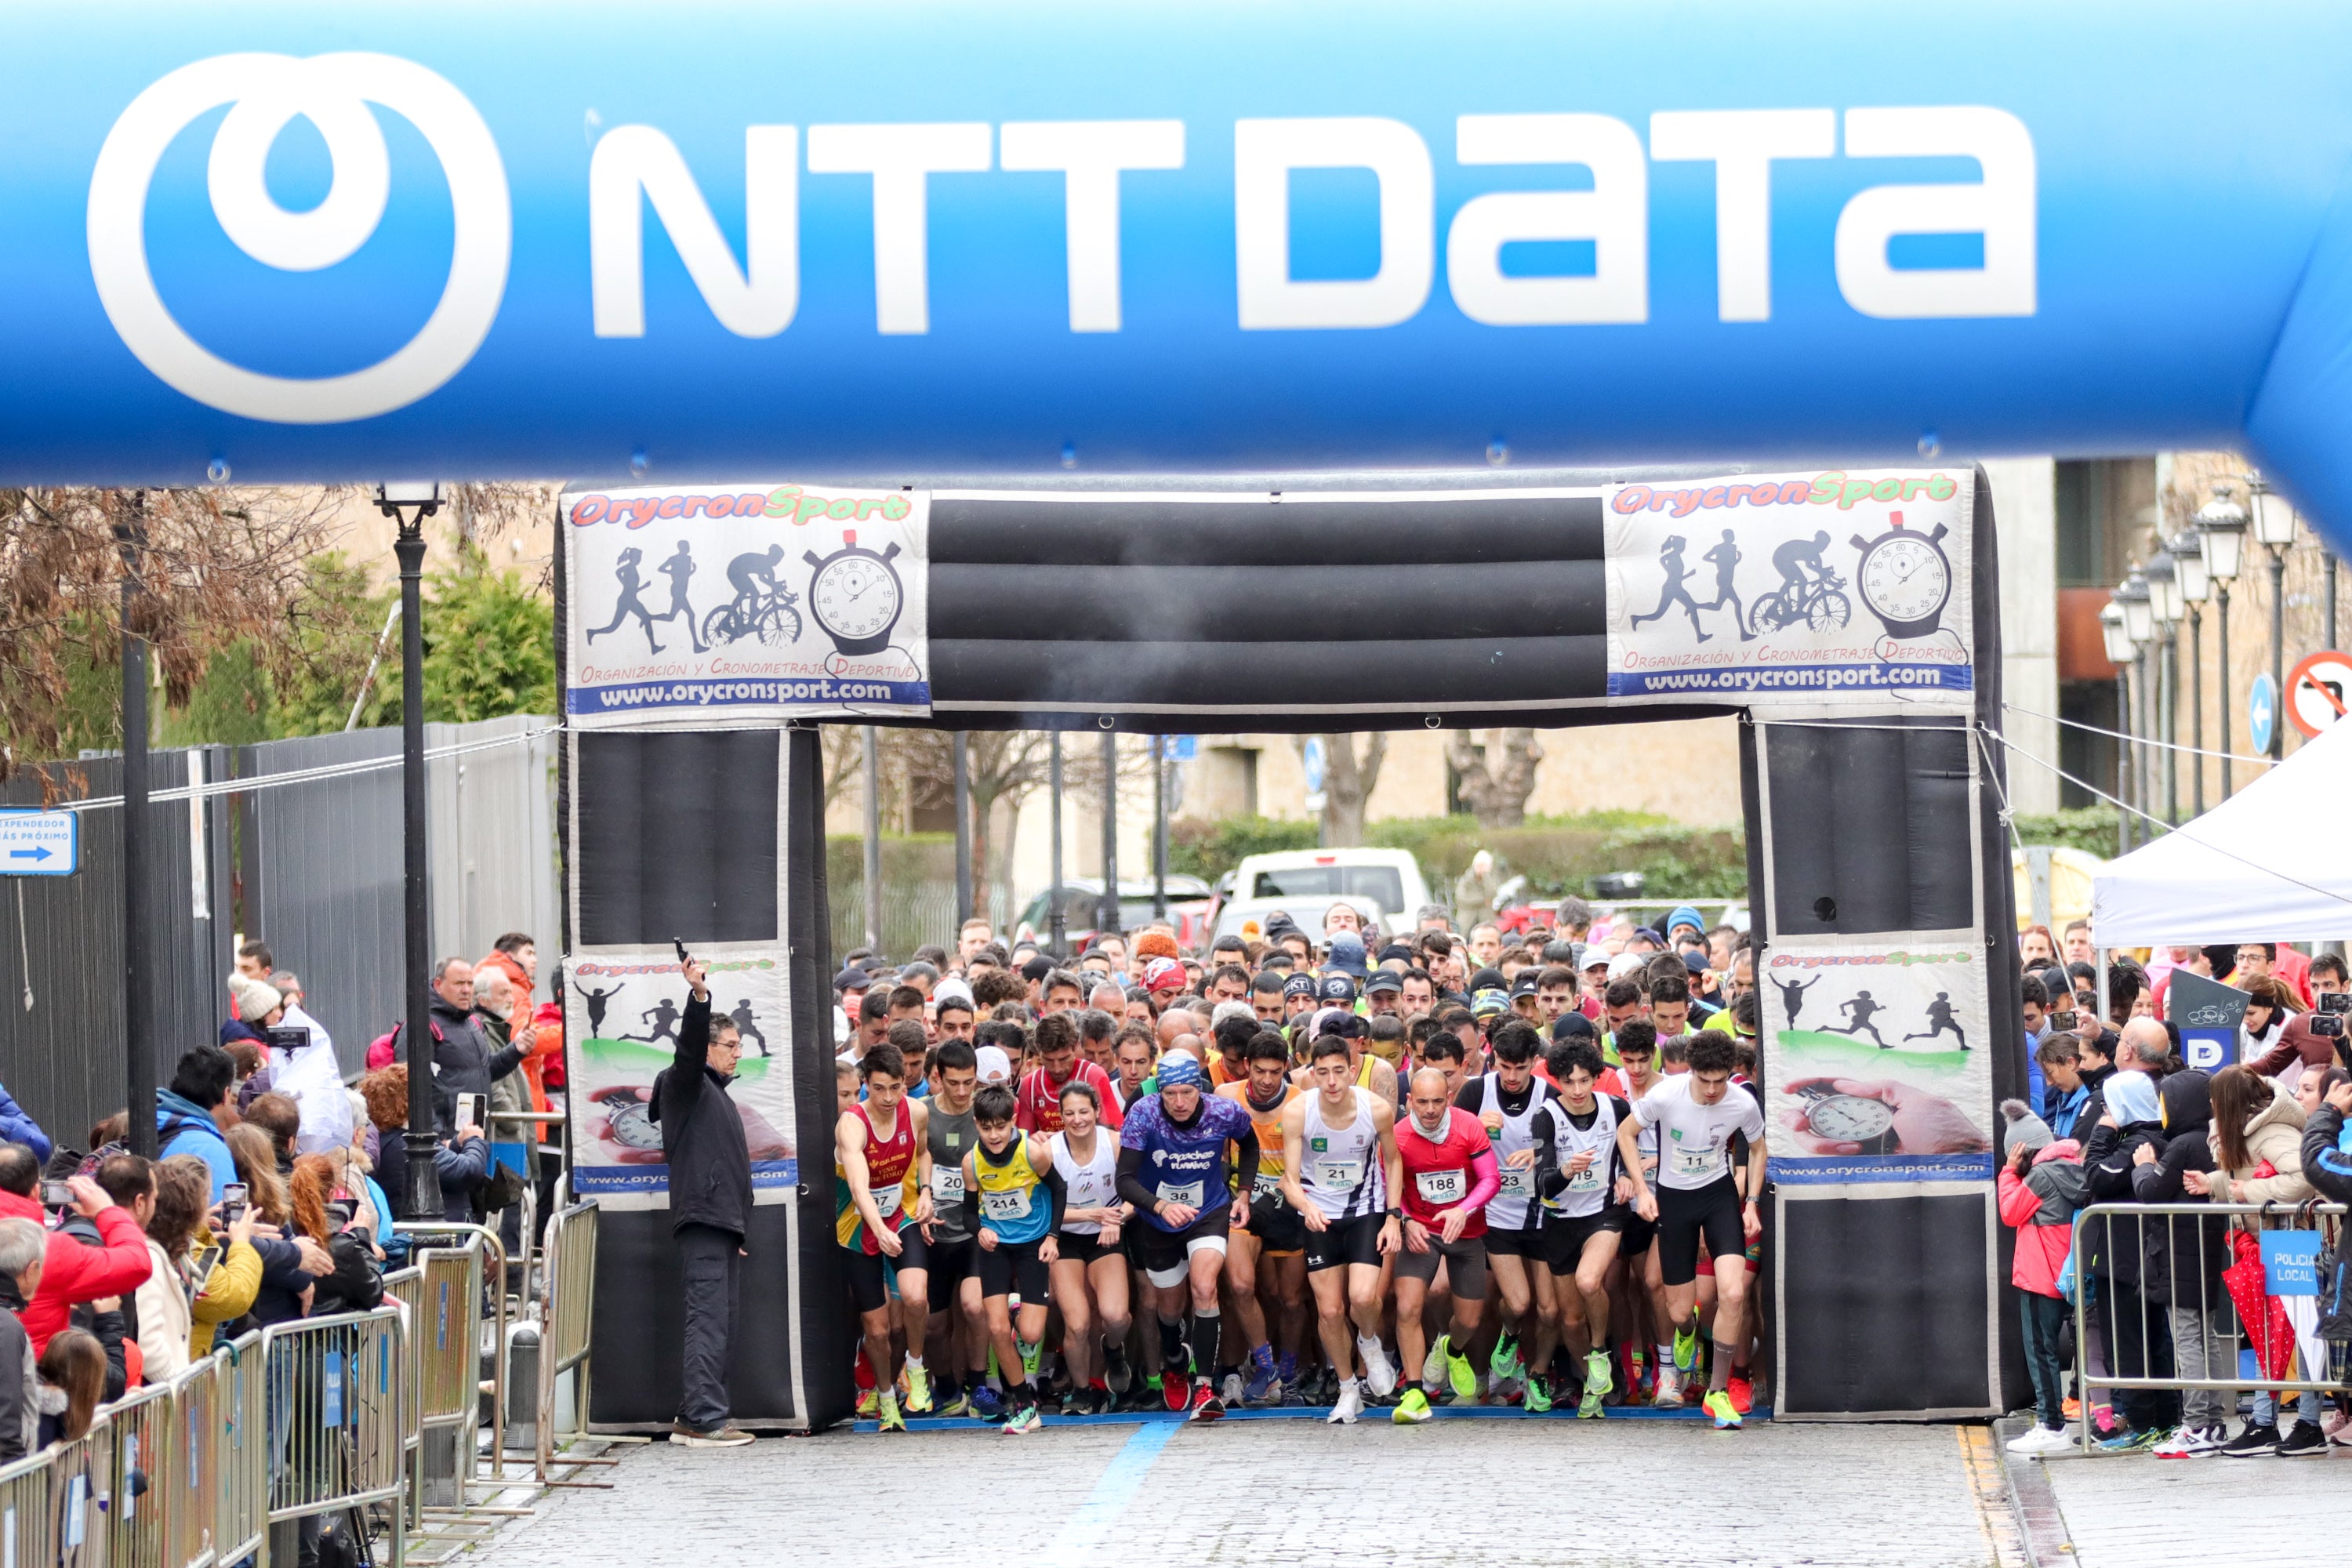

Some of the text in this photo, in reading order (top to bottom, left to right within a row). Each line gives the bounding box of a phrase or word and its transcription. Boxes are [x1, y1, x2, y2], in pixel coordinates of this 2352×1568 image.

[590, 119, 1185, 338] NTT
[1611, 471, 1957, 518] OrycronSport
[571, 485, 912, 529] OrycronSport
[1882, 550, 1891, 558] 55
[1890, 604, 1900, 612] 35
[855, 624, 866, 633] 30
[1644, 663, 1940, 691] www.orycronsport.com
[601, 680, 891, 706] www.orycronsport.com
[21, 831, 68, 840] PRÓXIMO
[1771, 951, 1972, 969] OrycronSport
[1686, 1156, 1702, 1166] 11
[1328, 1169, 1345, 1179] 21
[1778, 1163, 1984, 1176] www.orycronsport.com
[1501, 1176, 1519, 1186] 23
[1577, 1171, 1592, 1181] 19
[944, 1176, 962, 1189] 20
[1428, 1178, 1455, 1190] 188
[990, 1197, 1018, 1208] 214
[1170, 1192, 1189, 1201] 38
[2274, 1253, 2315, 1267] POLICIA
[2277, 1269, 2313, 1282] LOCAL
